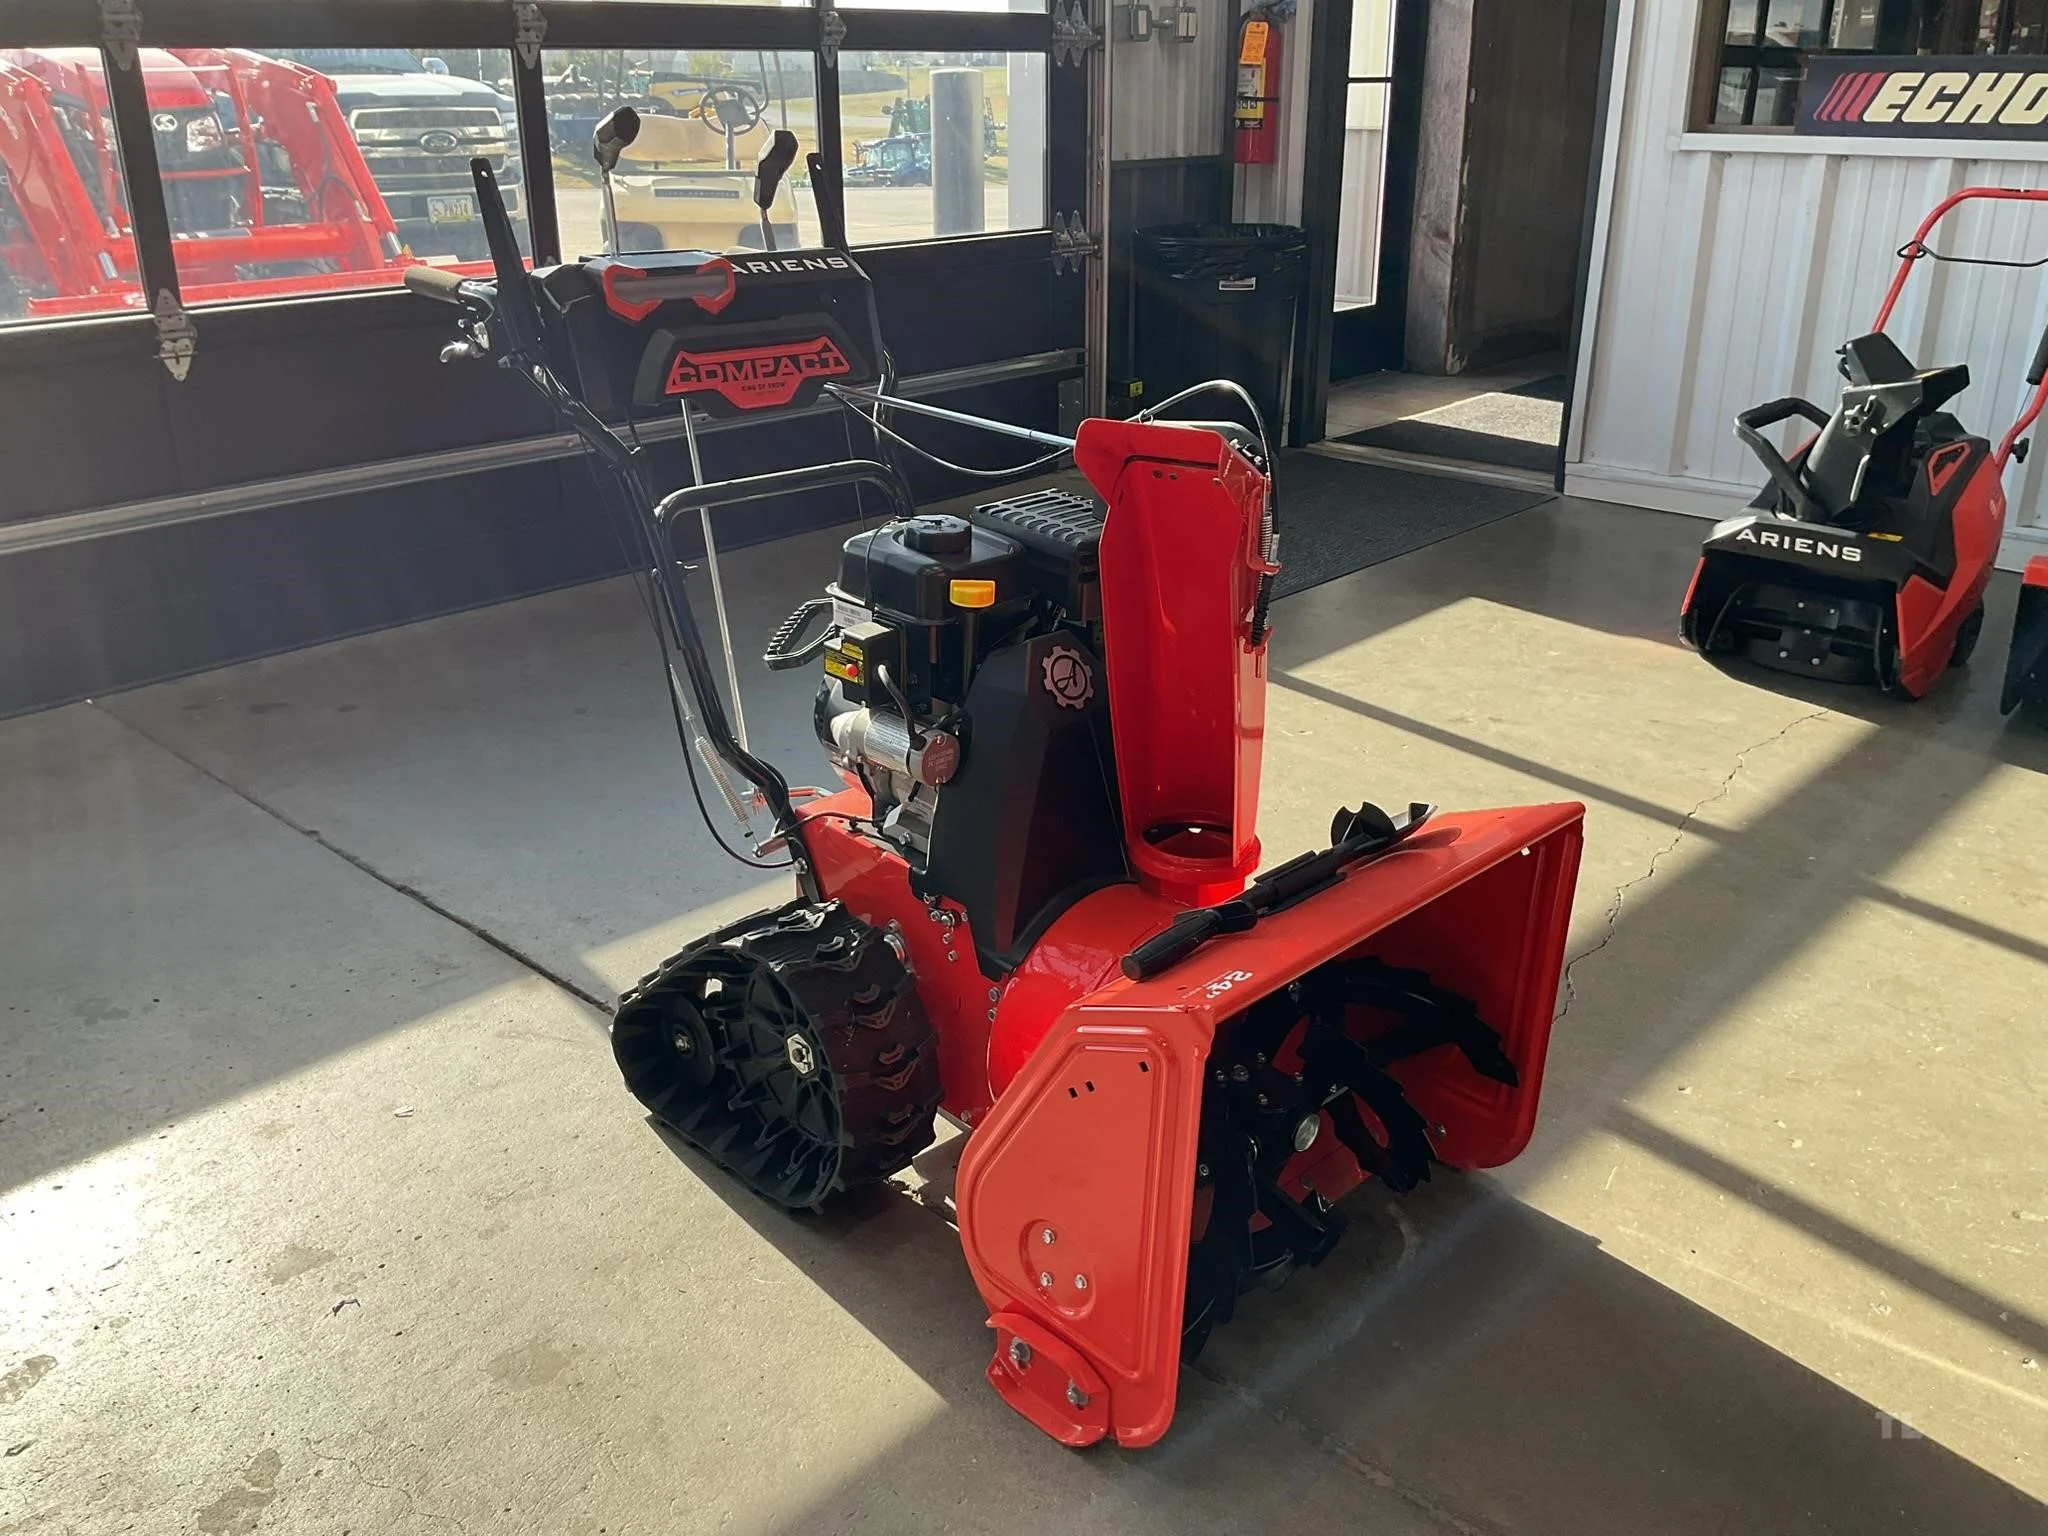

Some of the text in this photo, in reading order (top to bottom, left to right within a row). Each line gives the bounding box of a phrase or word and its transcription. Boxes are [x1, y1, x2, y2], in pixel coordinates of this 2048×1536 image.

[1862, 72, 2048, 124] ECHO
[674, 352, 846, 386] COMPACT
[1735, 528, 1862, 562] ARIENS
